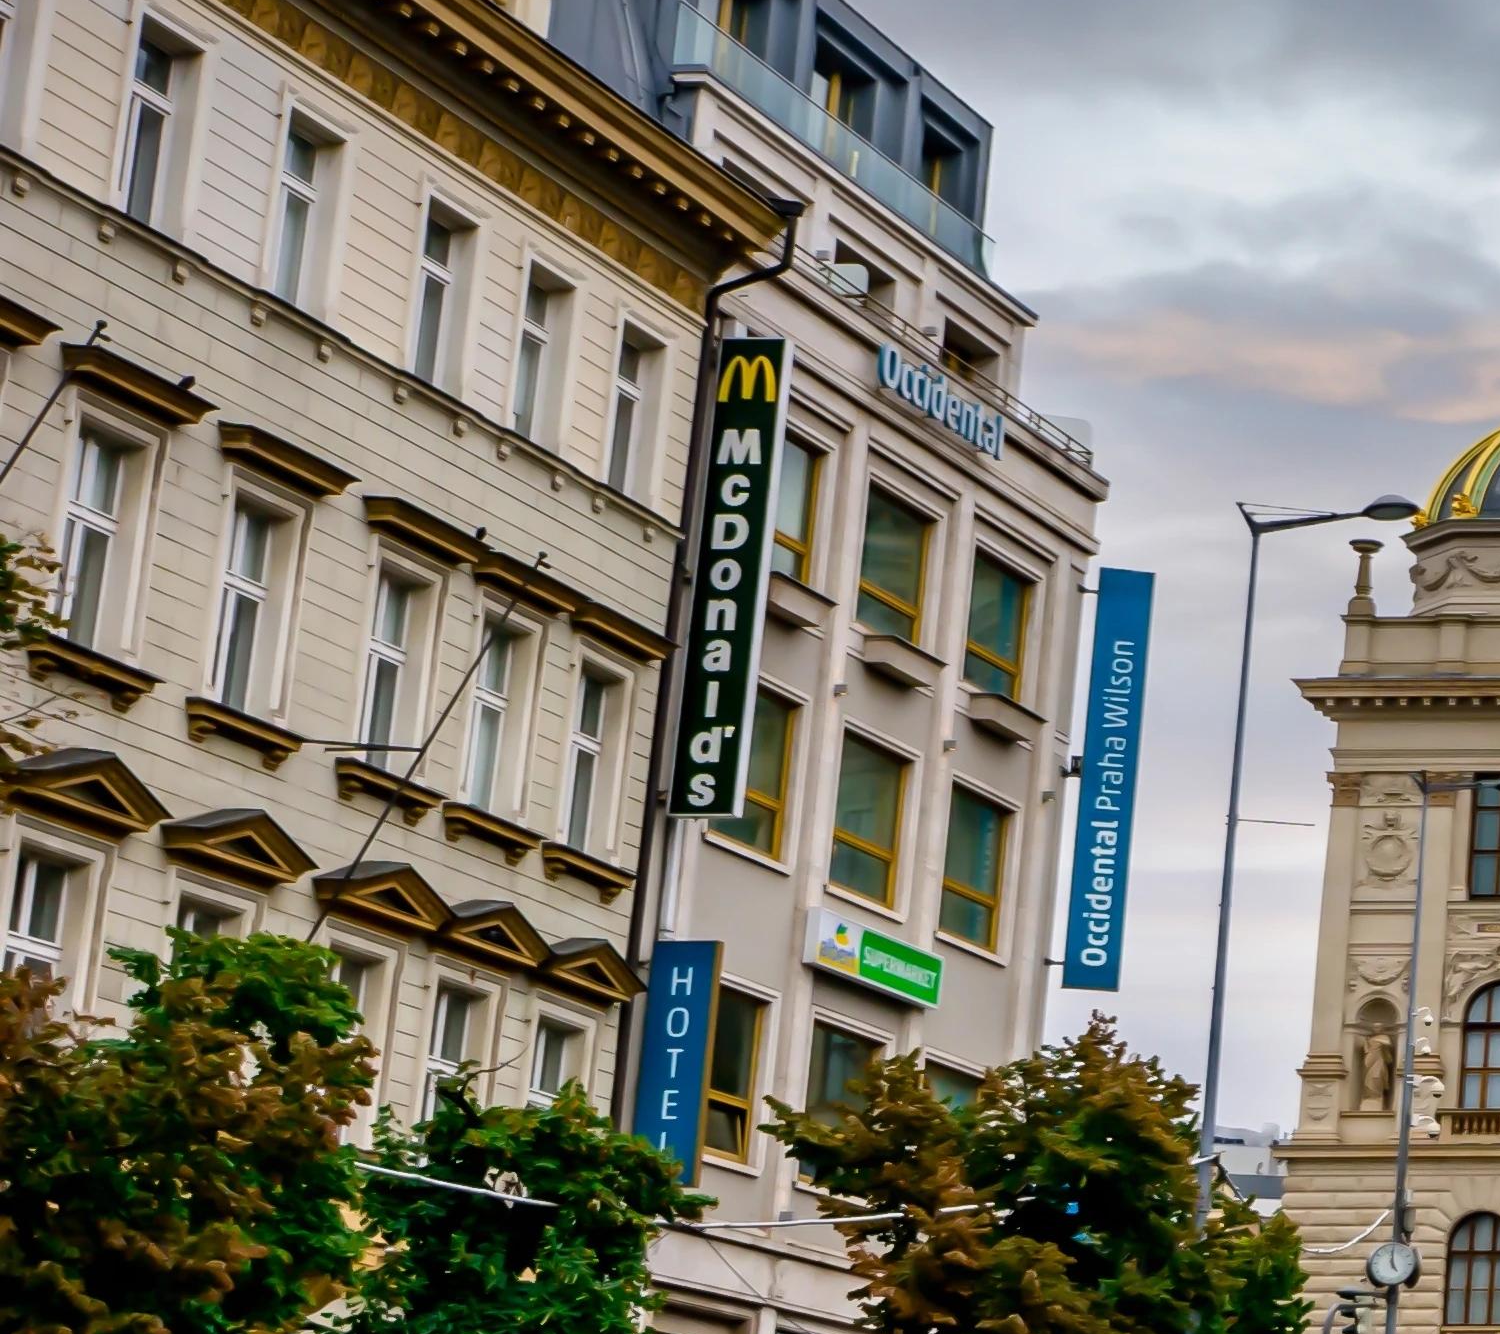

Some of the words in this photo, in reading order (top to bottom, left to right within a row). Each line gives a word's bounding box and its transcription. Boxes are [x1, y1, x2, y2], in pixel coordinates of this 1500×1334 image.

[877, 342, 1005, 461] Occidental
[688, 428, 762, 806] McDonald's
[1102, 639, 1135, 728] Wilson
[1095, 736, 1127, 811] Praha
[1080, 819, 1119, 967] Occidental
